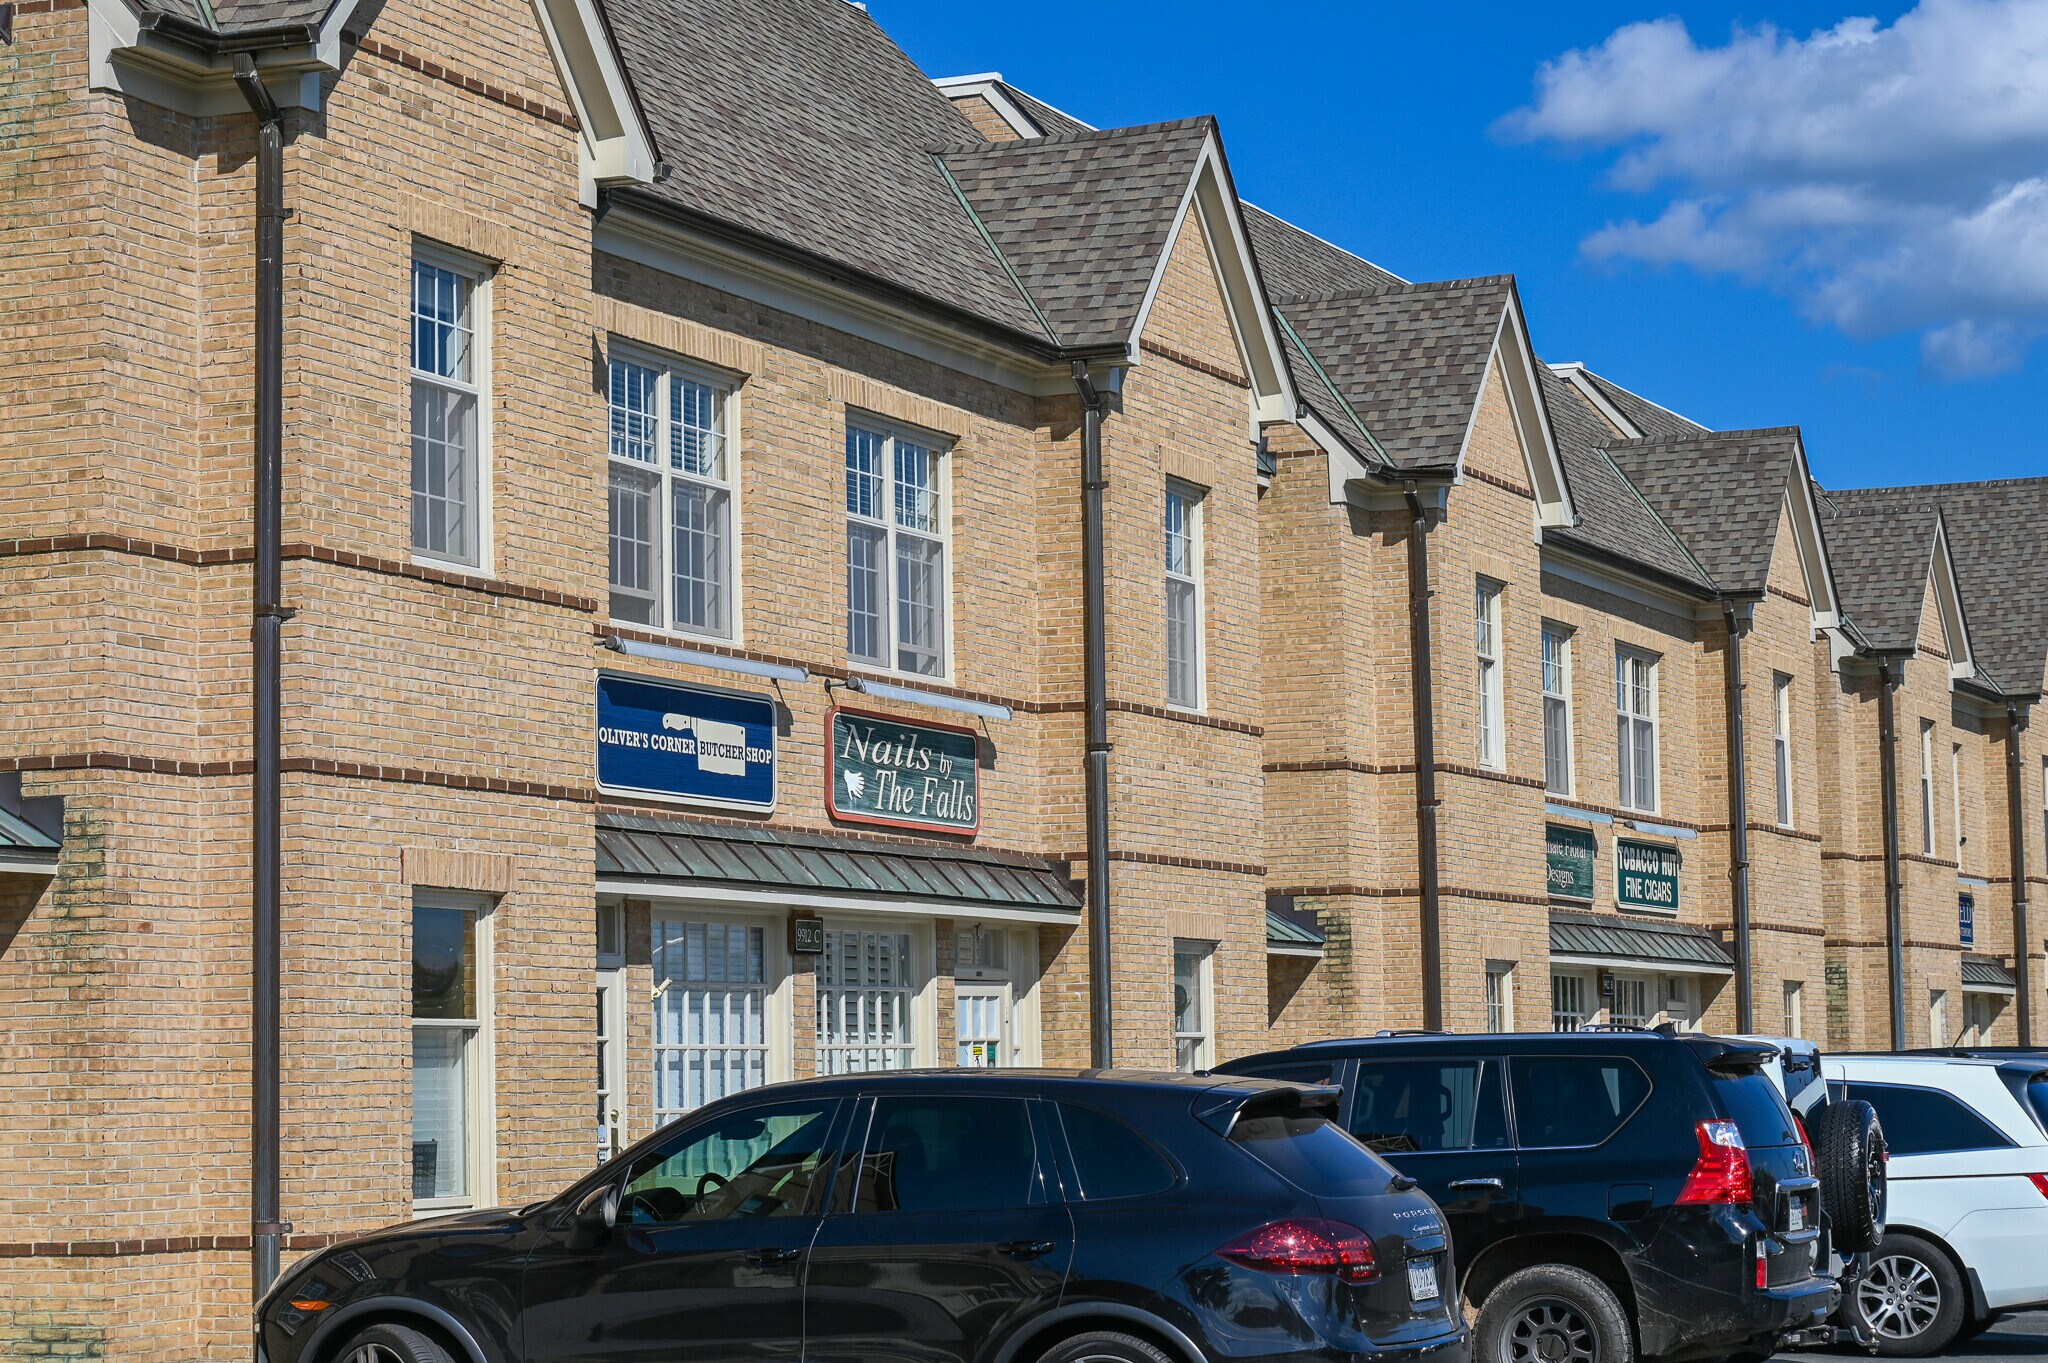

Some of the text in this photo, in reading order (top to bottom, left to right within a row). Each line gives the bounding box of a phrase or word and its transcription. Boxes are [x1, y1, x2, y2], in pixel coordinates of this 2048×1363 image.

[599, 726, 772, 765] OLIVER'S CORNER BUTCHER SHOP
[840, 723, 953, 780] Nails by
[875, 768, 974, 821] The Falls
[1617, 845, 1677, 877] TOBACCO HUT
[1625, 876, 1672, 903] FINE CIGARS
[813, 930, 820, 943] C
